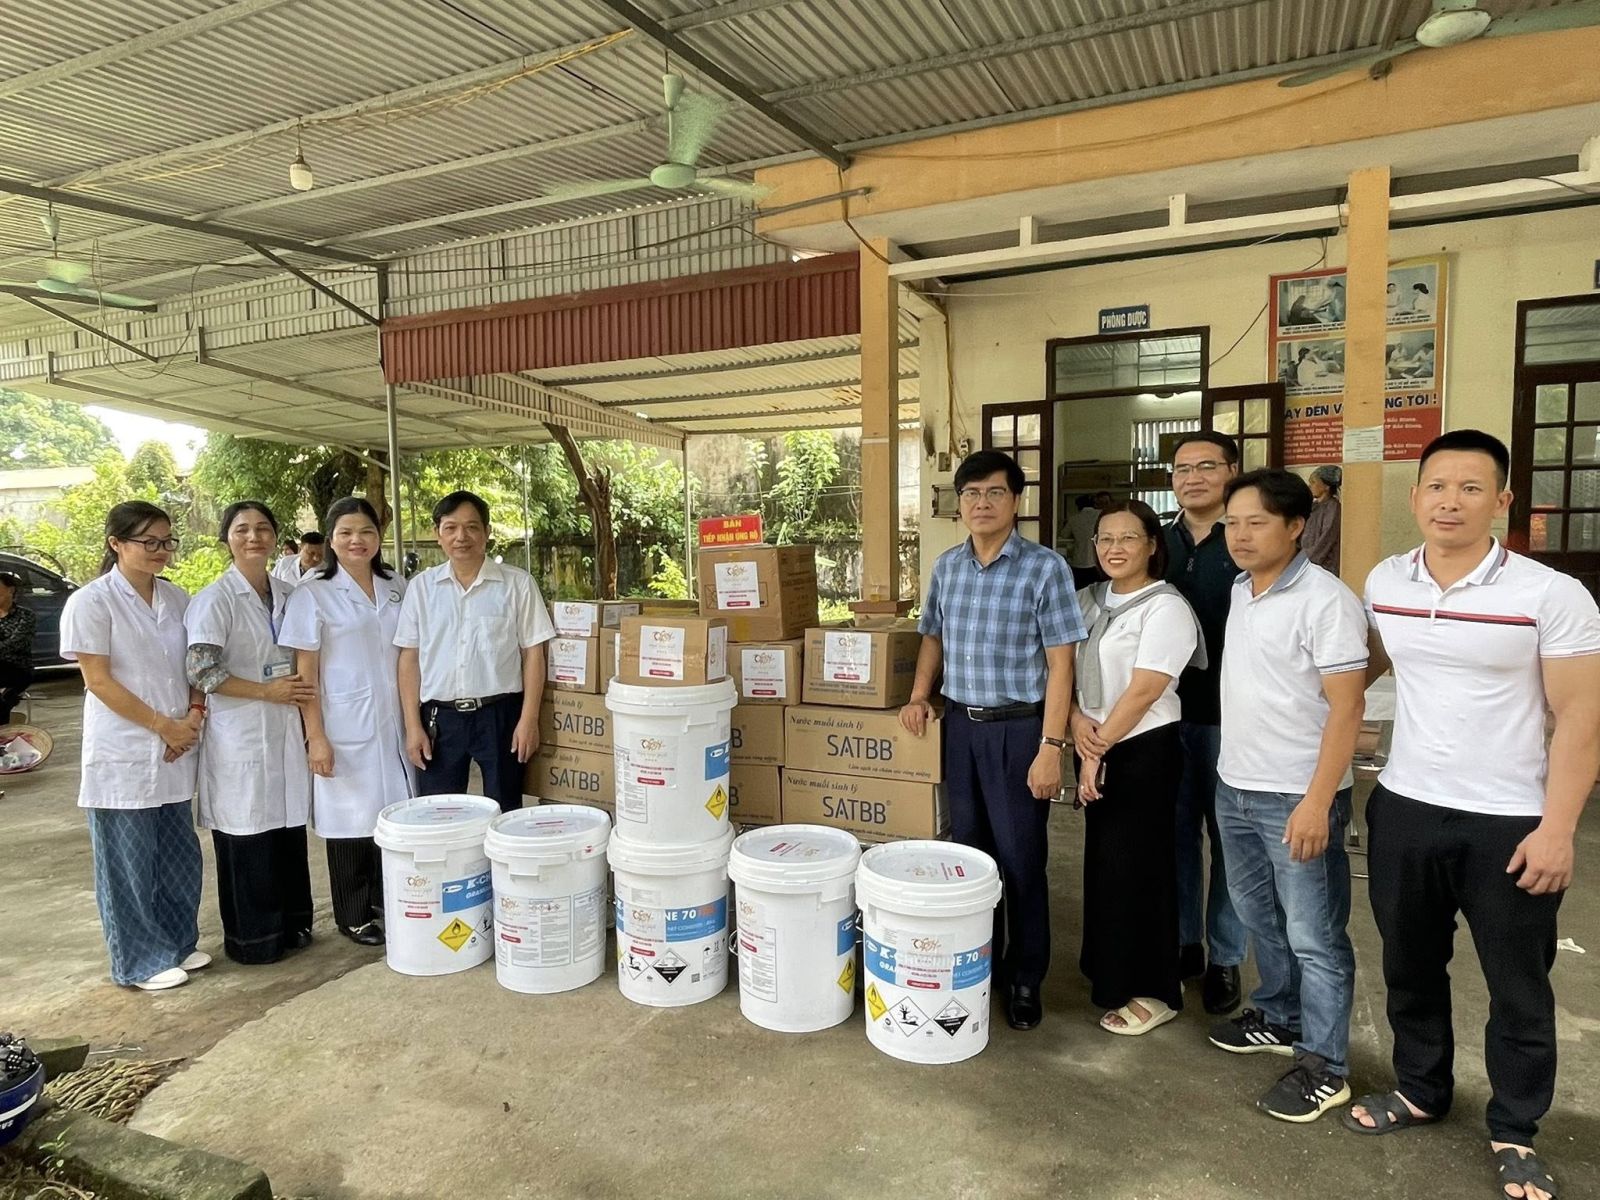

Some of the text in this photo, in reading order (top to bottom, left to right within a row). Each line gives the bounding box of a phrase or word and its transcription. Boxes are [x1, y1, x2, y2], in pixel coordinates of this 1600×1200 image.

[1101, 311, 1126, 329] PHÒNG
[553, 711, 605, 737] SATBB
[813, 715, 834, 728] muối
[836, 718, 854, 729] sinh
[827, 734, 893, 761] SATBB
[549, 766, 600, 792] SATBB
[822, 796, 887, 824] SATBB
[682, 909, 697, 920] 70
[966, 951, 979, 964] 70
